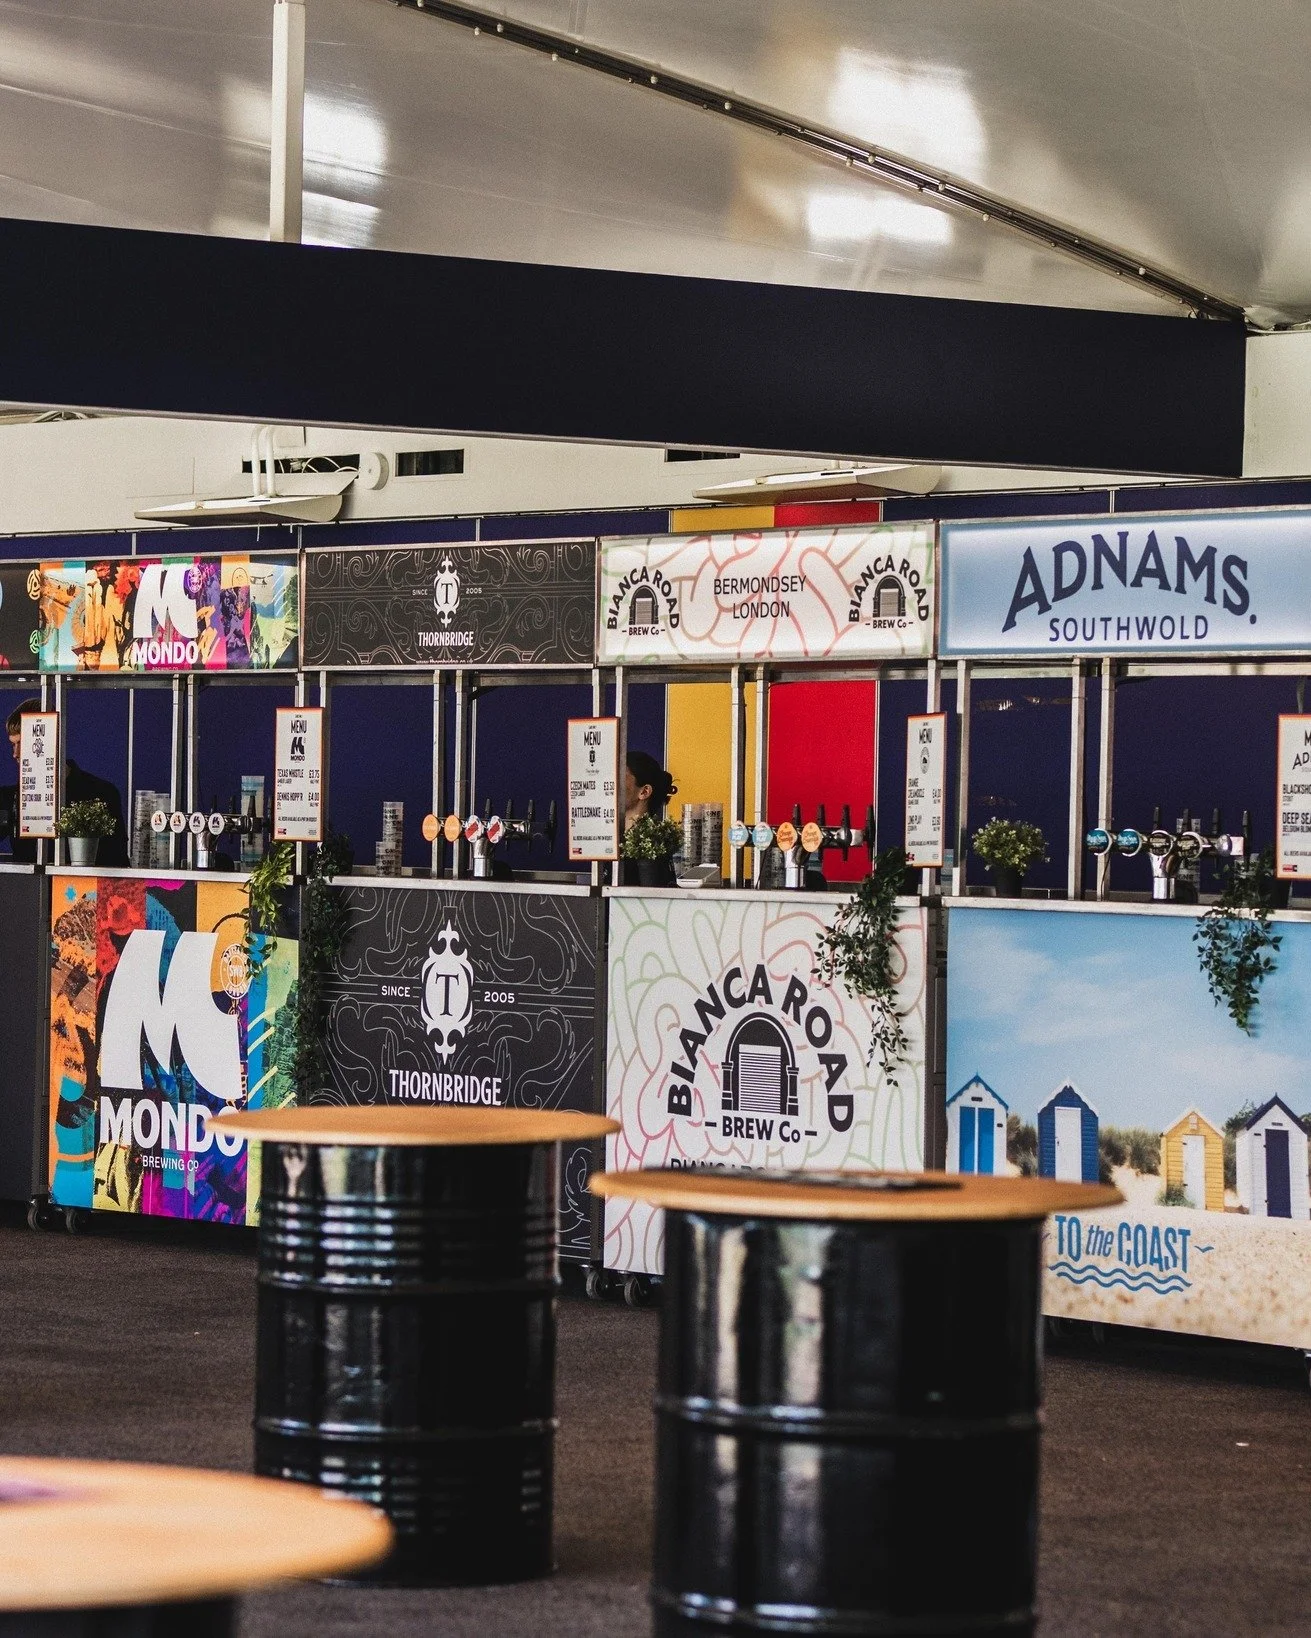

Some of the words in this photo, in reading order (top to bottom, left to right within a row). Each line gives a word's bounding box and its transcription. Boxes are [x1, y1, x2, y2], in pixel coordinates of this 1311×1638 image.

[465, 587, 482, 595] 2005
[714, 575, 807, 595] BERMONDSEY
[848, 554, 895, 622] BIANCA
[898, 558, 930, 621] ROAD
[607, 566, 650, 629] BIANCA
[652, 569, 680, 629] ROAD
[733, 601, 790, 619] LONDON
[628, 627, 649, 636] BREW
[872, 619, 896, 629] BREW
[1049, 615, 1209, 642] SOUTHWOLD
[418, 631, 474, 647] THORNBRIDGE
[130, 640, 199, 665] MONDO
[32, 724, 46, 737] MENU
[290, 719, 307, 733] MENU
[584, 731, 601, 746] MENU
[277, 769, 288, 778] TEXAS
[570, 781, 583, 791] CZECH
[583, 781, 596, 791] MATES
[277, 792, 290, 801] DENNIS
[571, 807, 602, 818] RATTLESNAKE
[1283, 812, 1299, 824] DEEP
[381, 985, 410, 997] SINCE
[484, 991, 515, 1004] 2005
[667, 964, 774, 1117] BIANCA
[781, 975, 854, 1133] ROAD
[389, 1069, 502, 1106] THORNBRIDGE
[100, 1096, 245, 1157] MONDO
[722, 1116, 774, 1141] BREW
[142, 1154, 185, 1171] BREWING
[1055, 1215, 1082, 1262] TO
[1085, 1224, 1114, 1258] the
[1118, 1222, 1191, 1273] COAST
